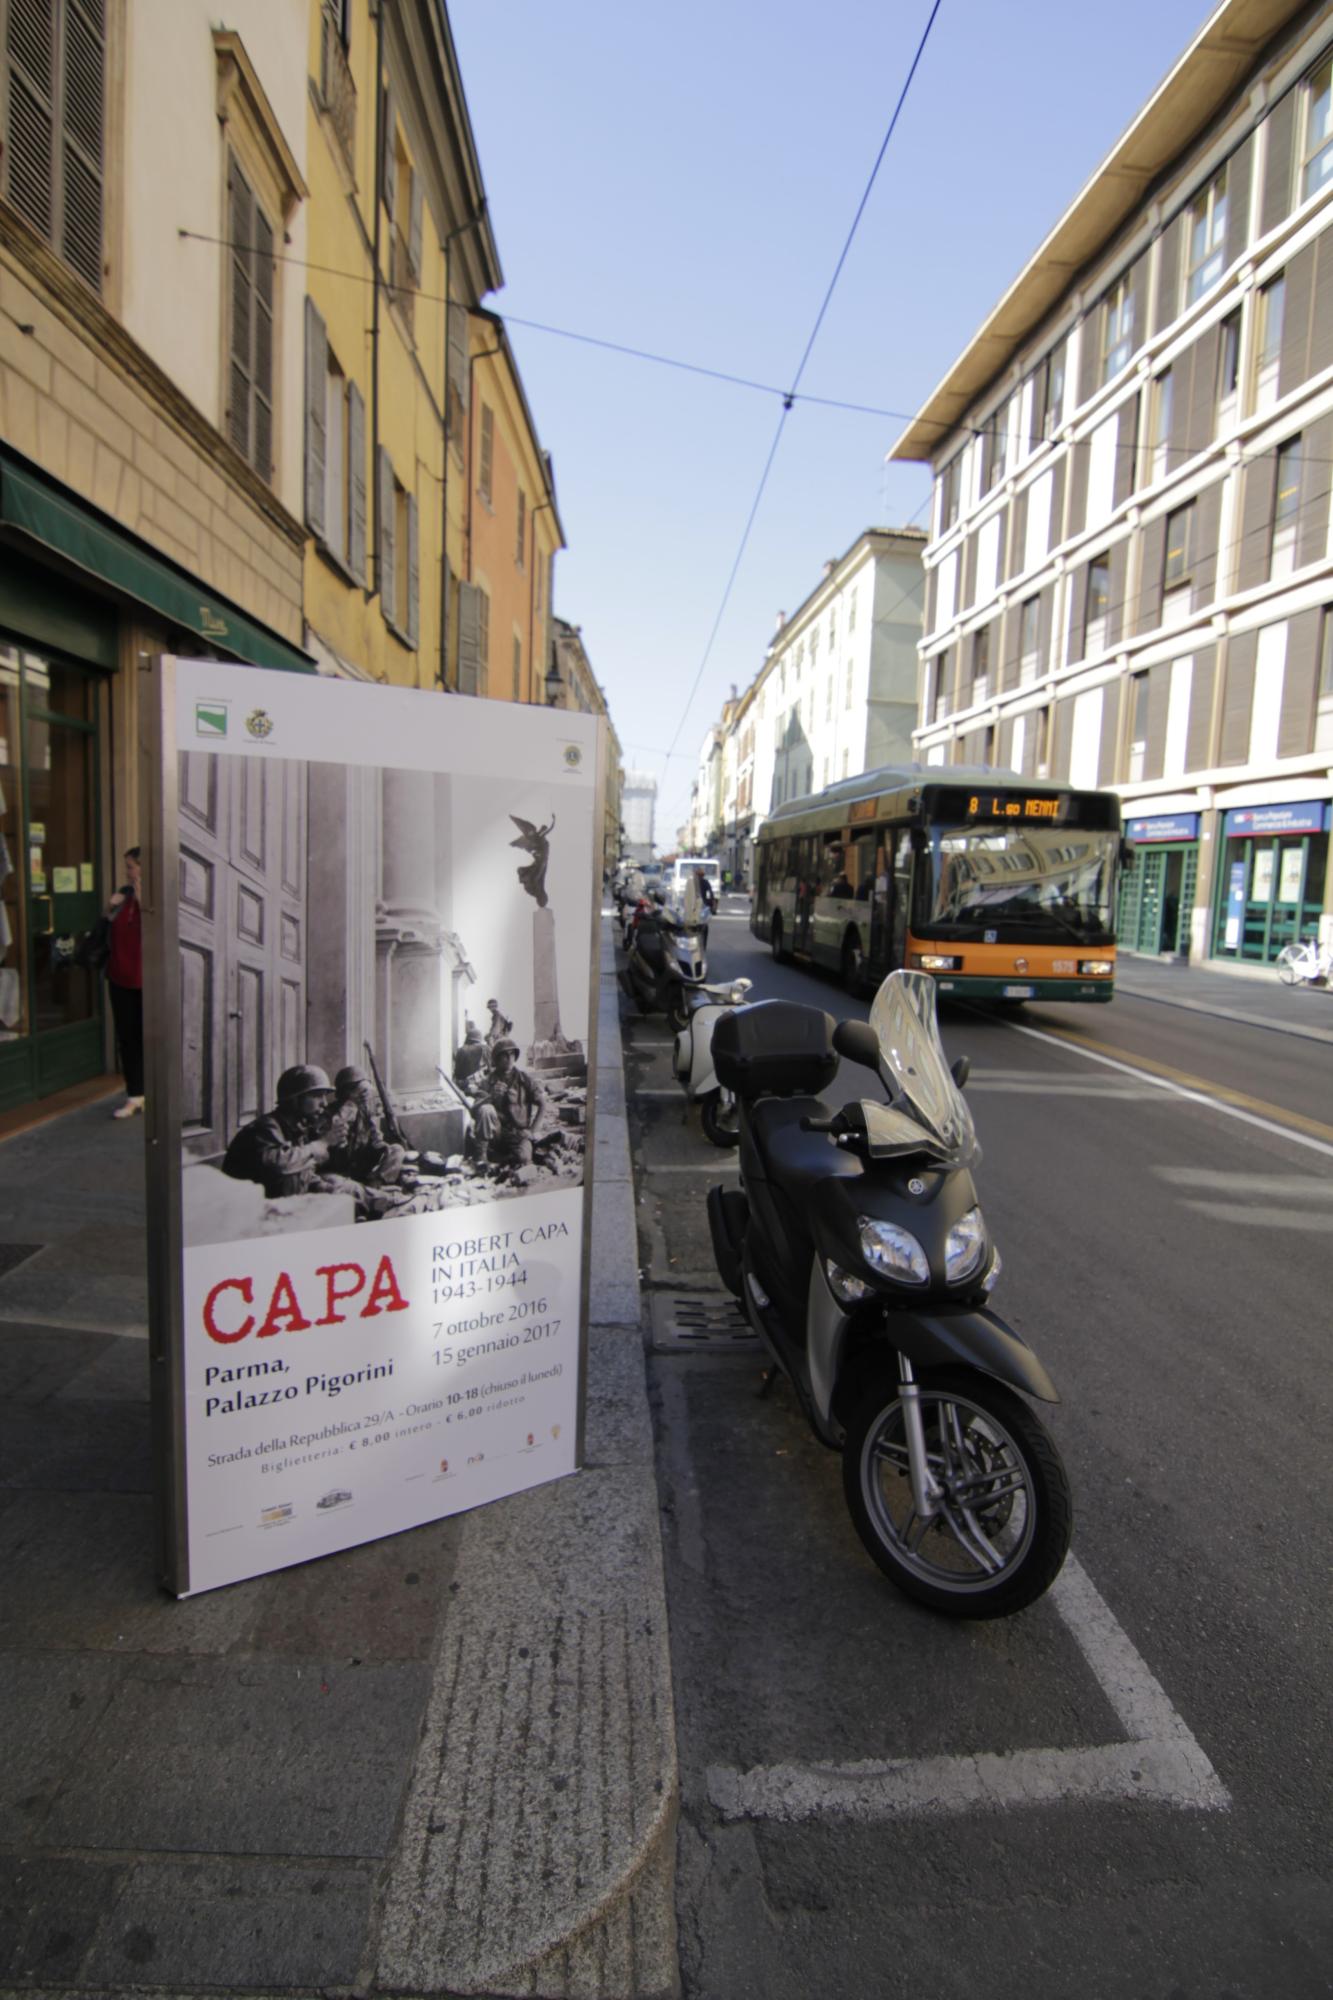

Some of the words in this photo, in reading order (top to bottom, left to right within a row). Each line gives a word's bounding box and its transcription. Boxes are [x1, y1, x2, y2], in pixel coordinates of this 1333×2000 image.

[968, 796, 980, 814] 8
[432, 1231, 513, 1262] ROBERT
[519, 1221, 569, 1245] CAPA
[432, 1265, 453, 1284] IN
[459, 1251, 520, 1278] ITALIA
[433, 1269, 528, 1304] 1943-1944
[202, 1254, 410, 1344] CAPA
[432, 1322, 443, 1339] 7
[446, 1311, 504, 1336] ottobre
[508, 1297, 548, 1321] 2016
[432, 1347, 453, 1366] 15
[456, 1333, 520, 1367] gennaio
[523, 1320, 561, 1343] 2017
[205, 1358, 291, 1387] Parma,
[205, 1385, 299, 1417] Palazzo
[305, 1358, 394, 1397] Pigorini
[207, 1446, 252, 1467] Strada
[254, 1438, 287, 1456] della
[289, 1421, 361, 1447] Repubblica
[364, 1410, 395, 1428] 29/A
[405, 1399, 444, 1417] Orario
[446, 1387, 480, 1405] 10-18
[481, 1377, 519, 1398] (chiuso
[520, 1373, 527, 1386] il
[260, 1445, 344, 1474] Biglietteria:
[395, 1421, 432, 1438] intero
[486, 1394, 526, 1412] ridotto
